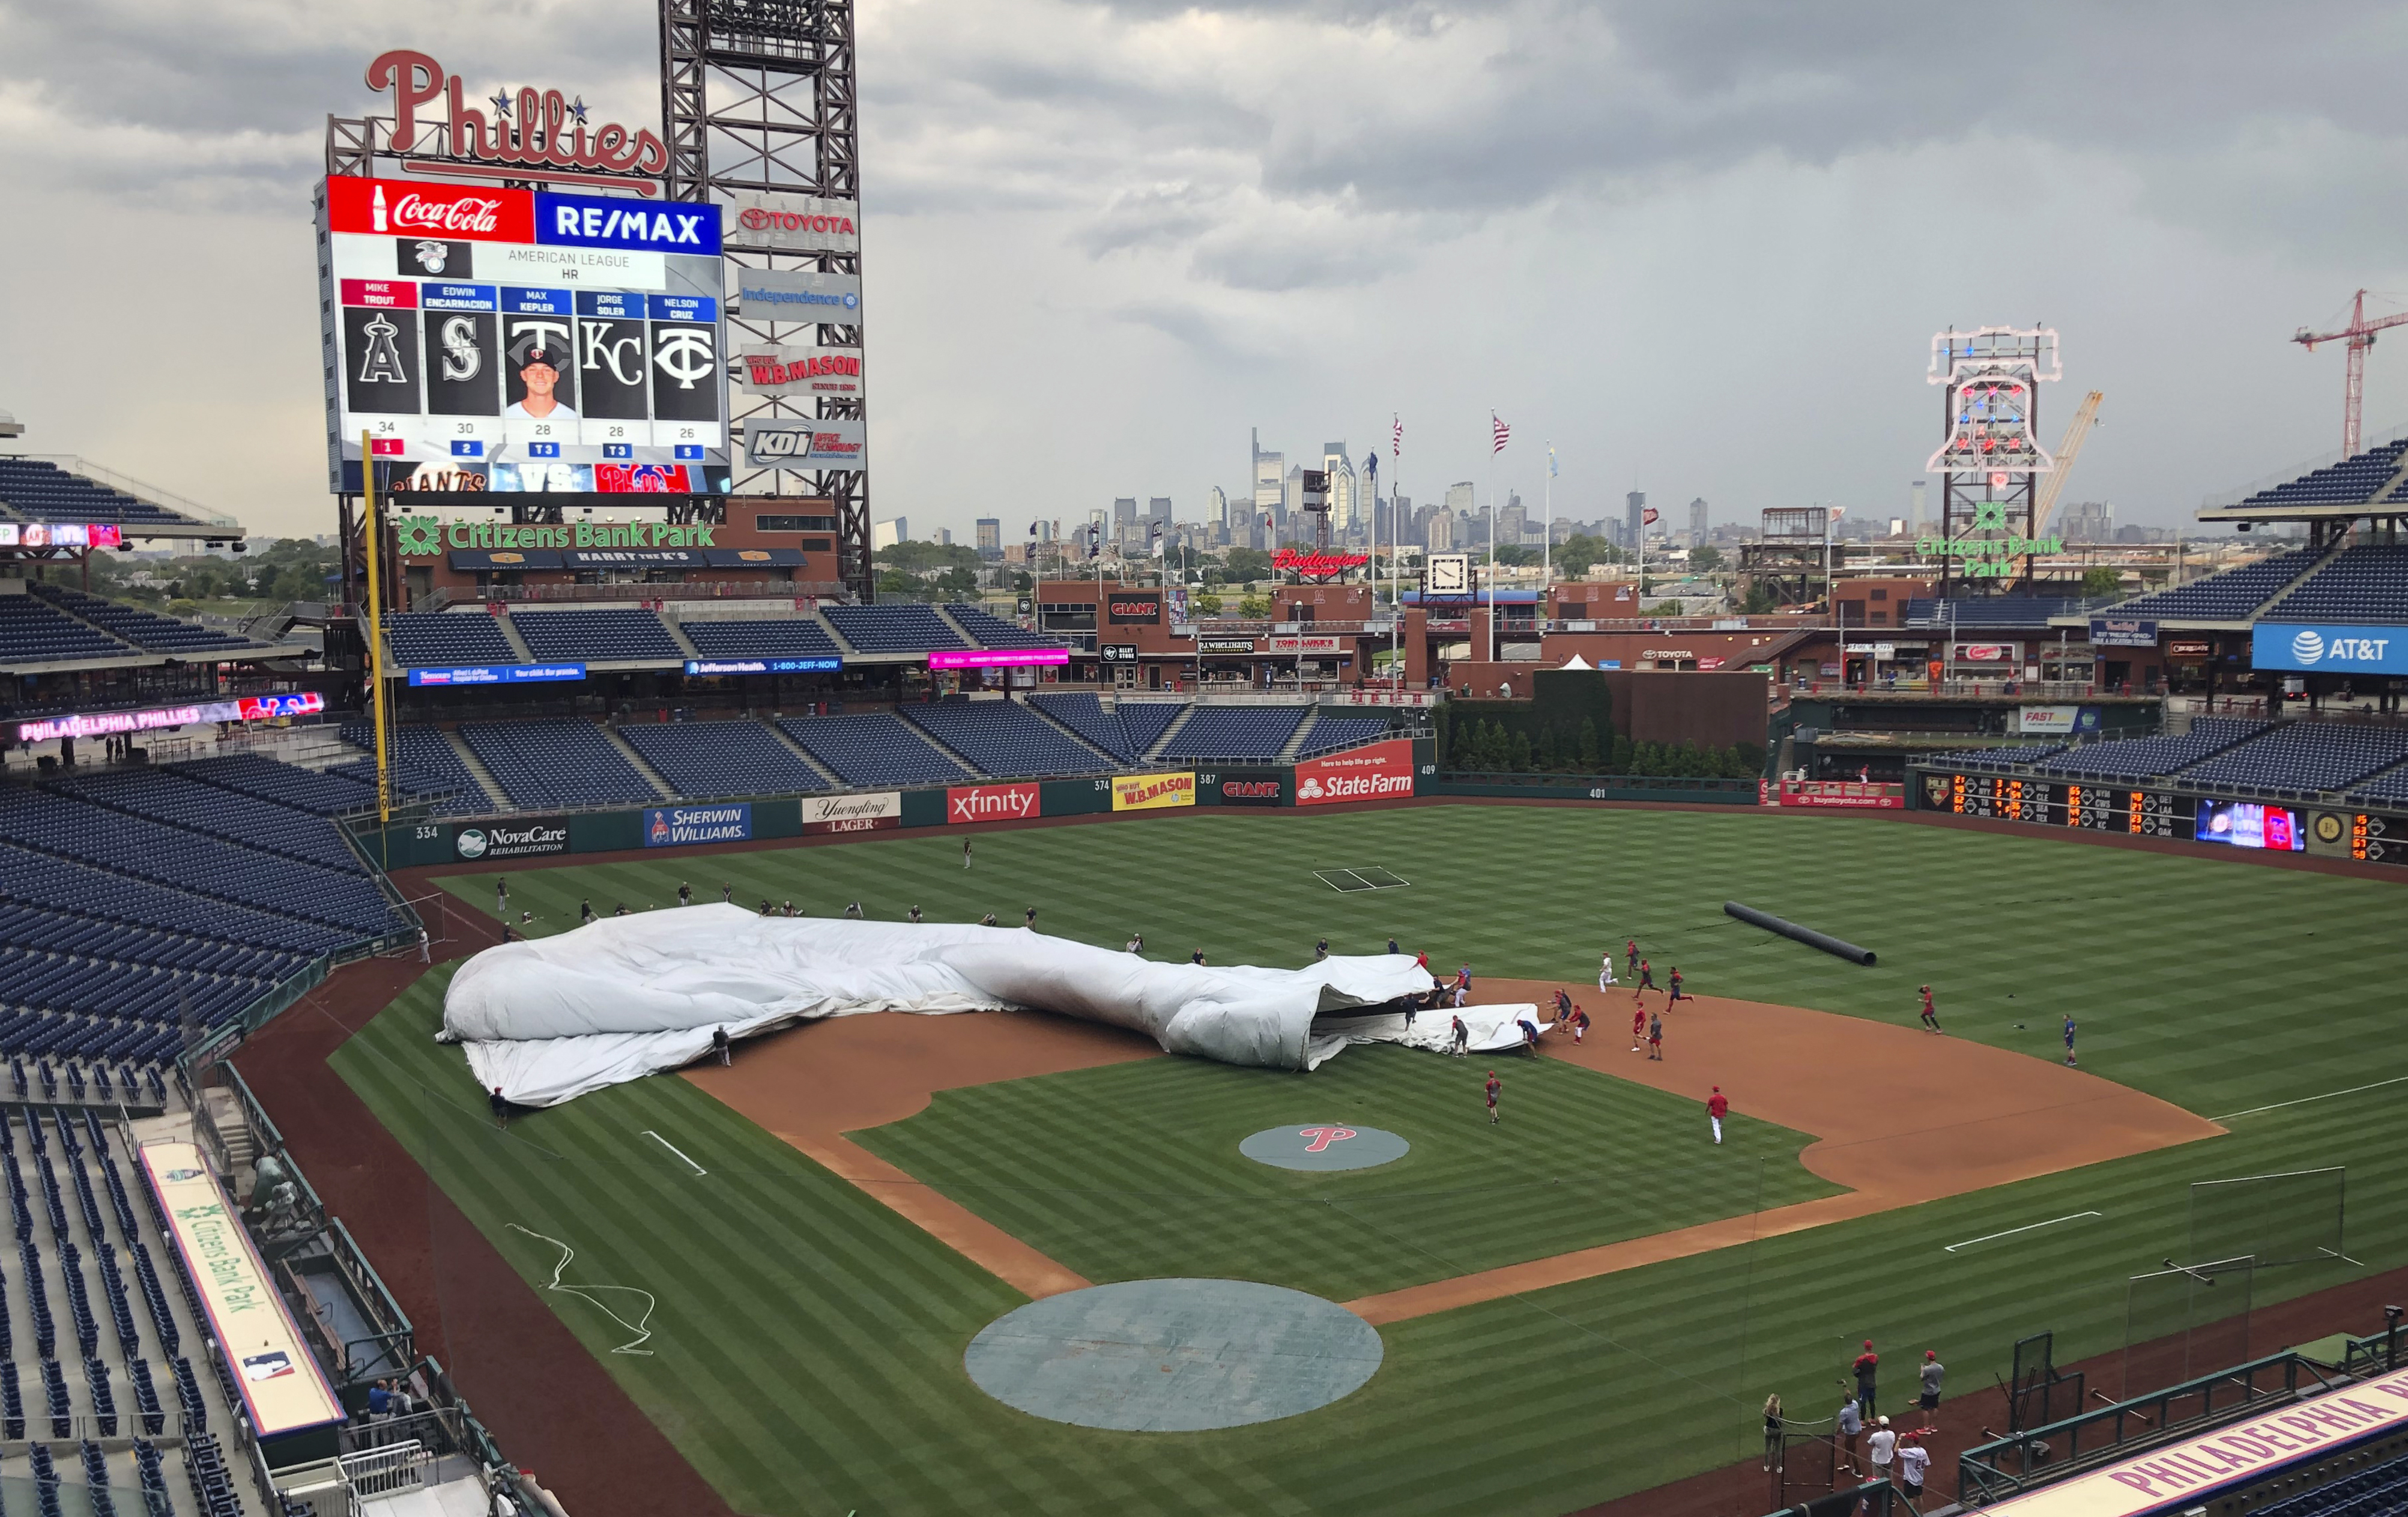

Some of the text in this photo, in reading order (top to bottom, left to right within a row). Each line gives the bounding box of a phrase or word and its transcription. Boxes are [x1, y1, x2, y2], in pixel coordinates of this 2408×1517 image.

[365, 49, 669, 174] Phillies
[393, 193, 503, 232] Coca-Cola
[557, 206, 701, 244] RE/MAX
[770, 212, 855, 235] TOYOTA
[509, 249, 630, 268] AMERICAN LEAGUE
[562, 268, 578, 279] HR
[365, 283, 390, 292] MIKE
[443, 286, 476, 297] EDWIN
[363, 295, 395, 305] TROUT
[526, 291, 547, 300] MAX
[597, 295, 623, 304] JORGE
[743, 287, 840, 306] Independence
[425, 298, 492, 309] ENCARNACION
[519, 302, 555, 312] KEPLER
[664, 298, 698, 308] NELSON
[597, 306, 625, 316] SOLER
[670, 310, 694, 320] CRUZ
[379, 422, 395, 432] 34
[457, 423, 473, 434] 30
[535, 425, 551, 435] 28
[609, 426, 624, 437] 28
[680, 428, 694, 438] 26
[384, 443, 392, 452] 1
[462, 443, 471, 453] 2
[753, 431, 812, 456] KDI
[683, 447, 692, 457] 5
[448, 519, 715, 548] Citizens Bank Park
[1915, 534, 2065, 556] Citizens Bank
[577, 552, 636, 561] HARRY
[661, 552, 689, 561] K'S
[1270, 548, 1369, 569] Budweiser
[1964, 558, 2013, 577] Park
[1111, 602, 1157, 616] GIANT
[2329, 638, 2389, 660] AT&T
[700, 661, 766, 673] Jefferson Health.
[773, 660, 838, 671] 1-800-JEFF-NOW
[420, 670, 451, 680] Nemours
[2025, 712, 2054, 721] FAST
[19, 707, 200, 741] PHILADELPHIA PHILLIES
[1421, 765, 1436, 775] 409
[1200, 774, 1215, 784] 387
[1094, 780, 1109, 791] 374
[1223, 781, 1280, 798] GIANT
[1590, 788, 1606, 799] 401
[954, 789, 1034, 820] xfinity
[1814, 796, 1876, 805] buyatoyota.com
[815, 797, 889, 820] Yuengling
[672, 809, 742, 825] SHERWIN
[831, 819, 874, 832] LAGER
[2098, 821, 2107, 829] KC
[416, 826, 438, 839] 334
[489, 826, 565, 846] NovaCare
[2158, 828, 2173, 837] OAK
[489, 843, 563, 855] REHABILITATION
[1299, 1127, 1357, 1152] P
[191, 1220, 265, 1313] Citizens Bank Park
[2108, 1397, 2398, 1498] PHILADELPHIA
